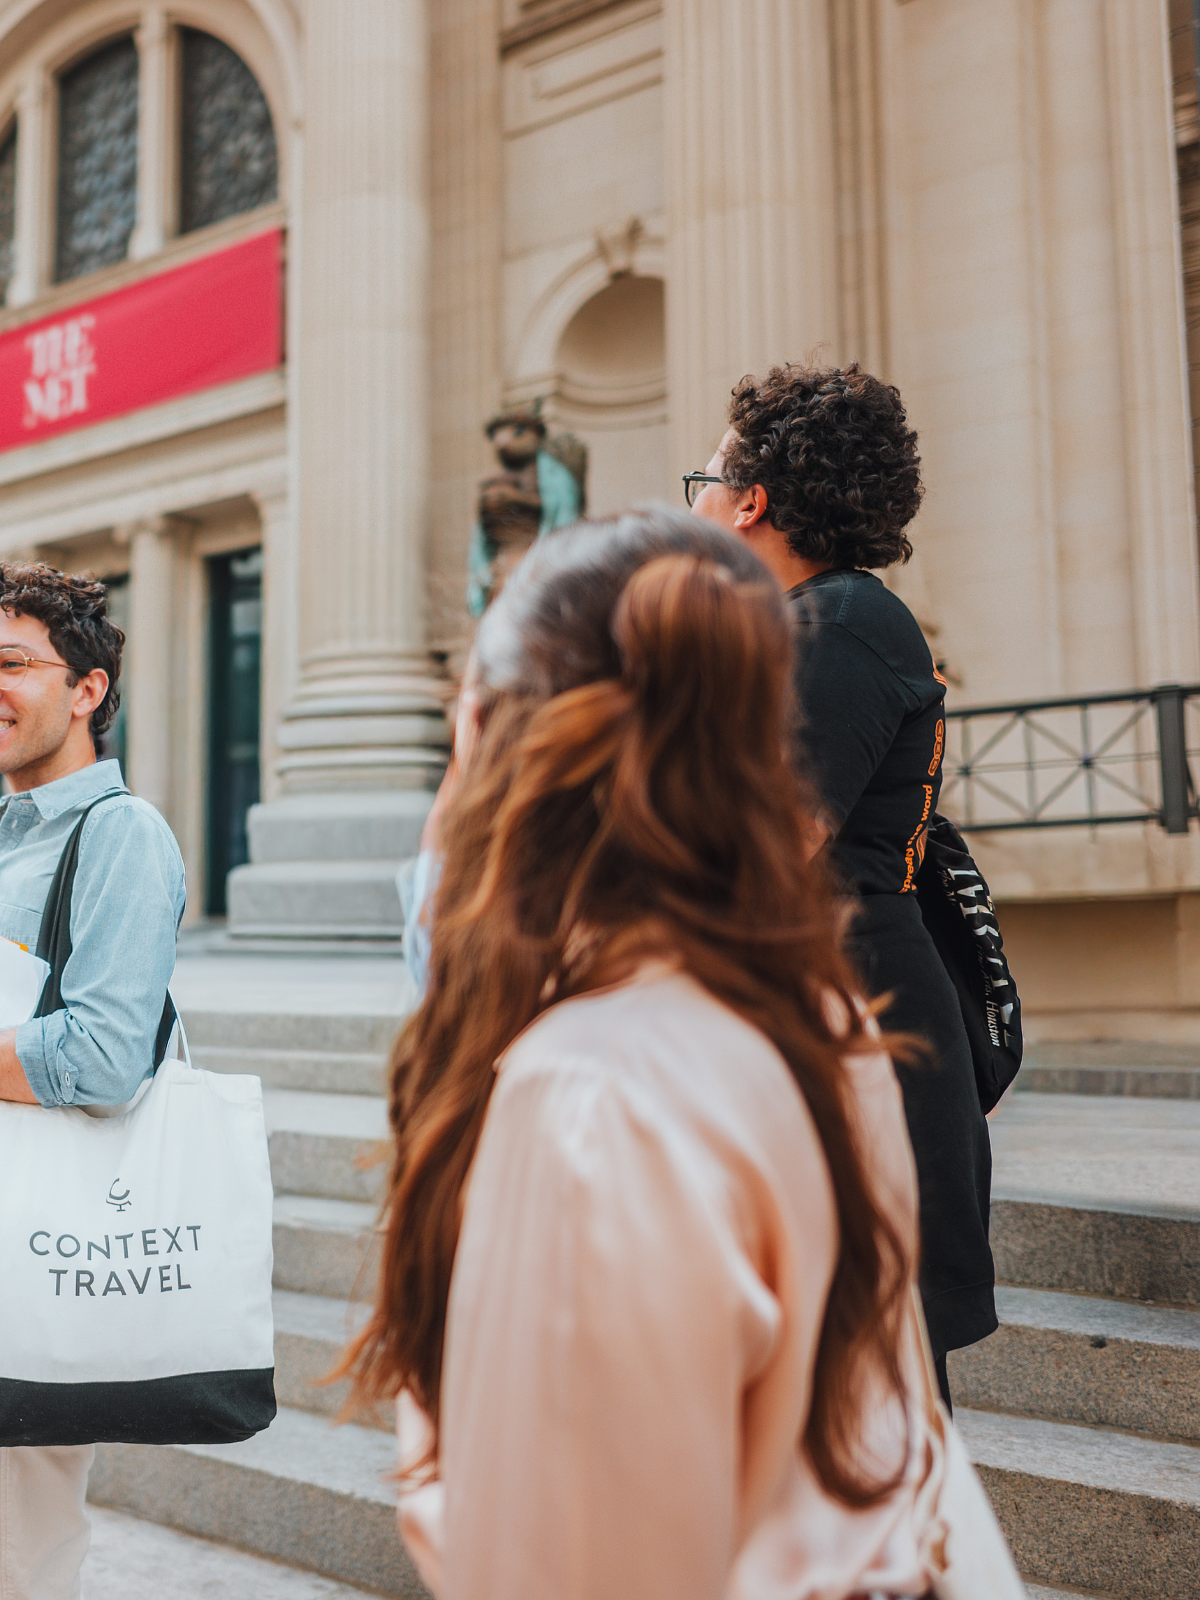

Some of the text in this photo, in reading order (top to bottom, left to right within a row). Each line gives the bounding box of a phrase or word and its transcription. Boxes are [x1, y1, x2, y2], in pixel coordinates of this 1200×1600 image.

[25, 315, 96, 376] THE
[23, 366, 95, 429] MET
[921, 784, 933, 822] word
[986, 1000, 1000, 1047] Houston
[29, 1225, 202, 1261] CONTEXT
[48, 1264, 192, 1296] TRAVEL
